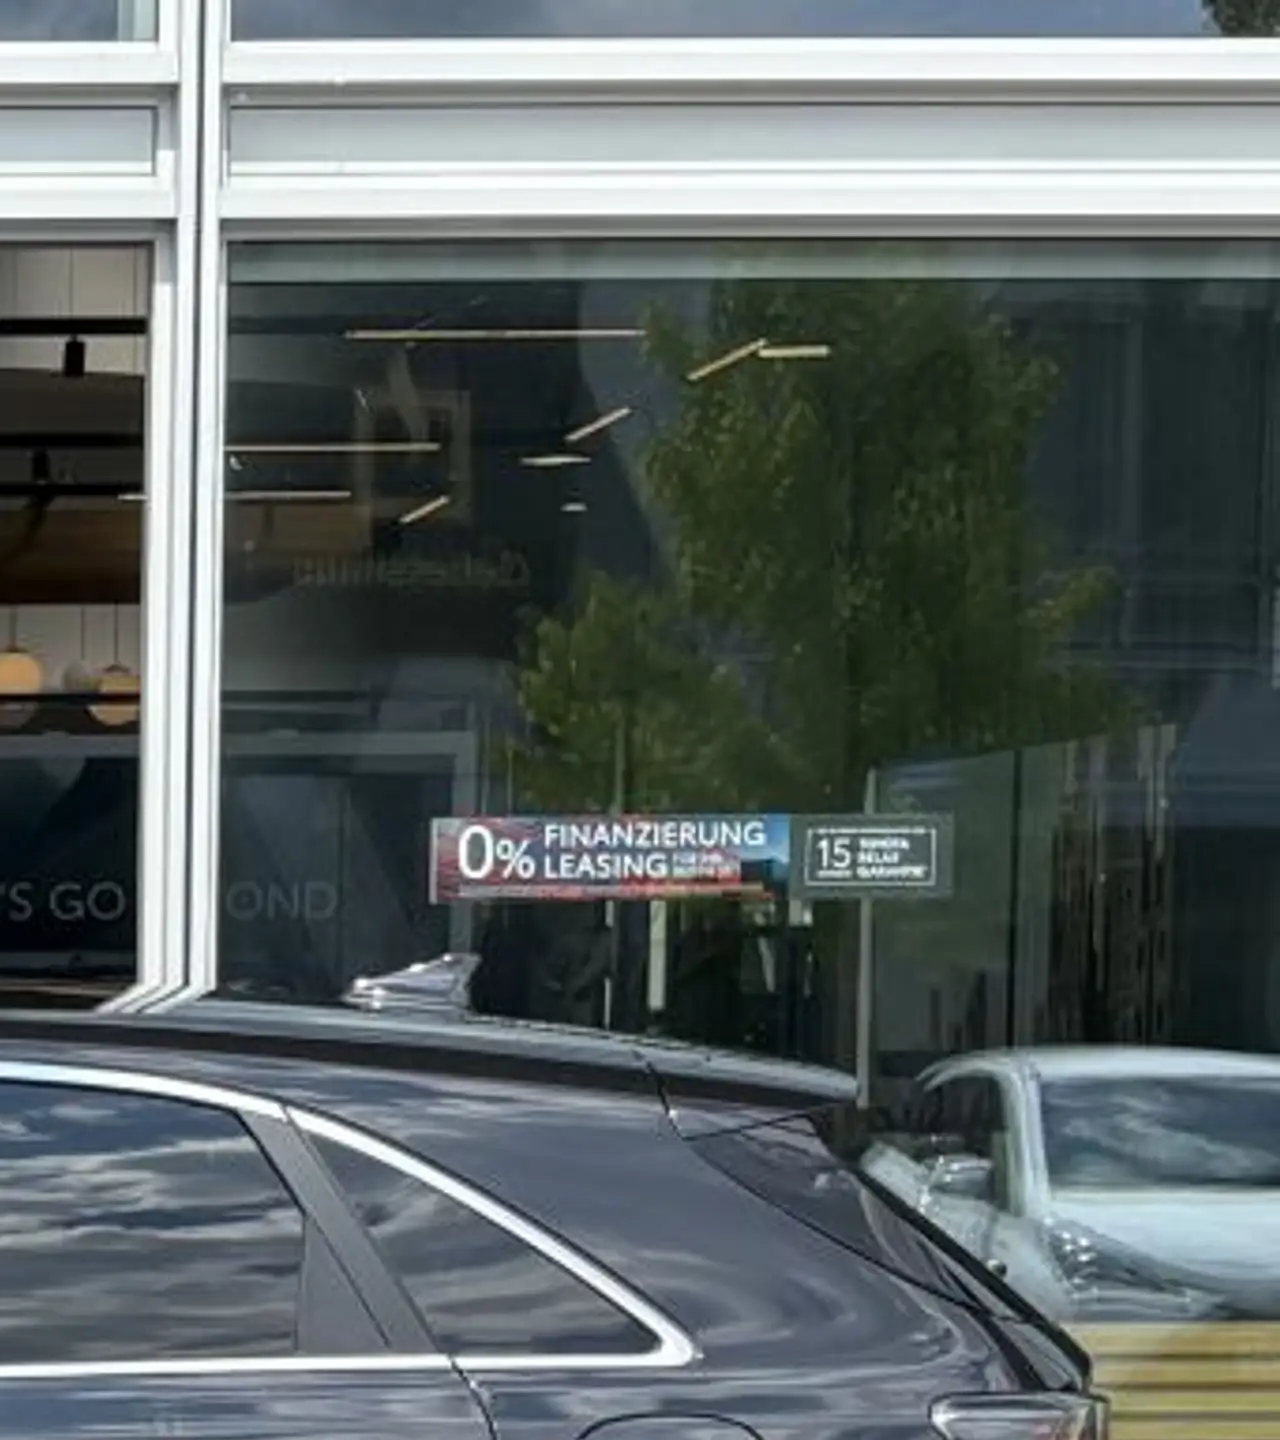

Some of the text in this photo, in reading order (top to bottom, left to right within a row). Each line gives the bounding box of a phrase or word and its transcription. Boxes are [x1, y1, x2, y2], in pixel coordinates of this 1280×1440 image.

[544, 821, 766, 847] FINANZIERUNG
[458, 825, 536, 879] 0%
[544, 853, 669, 879] LEASING
[816, 837, 851, 869] 15
[50, 880, 126, 921] GO
